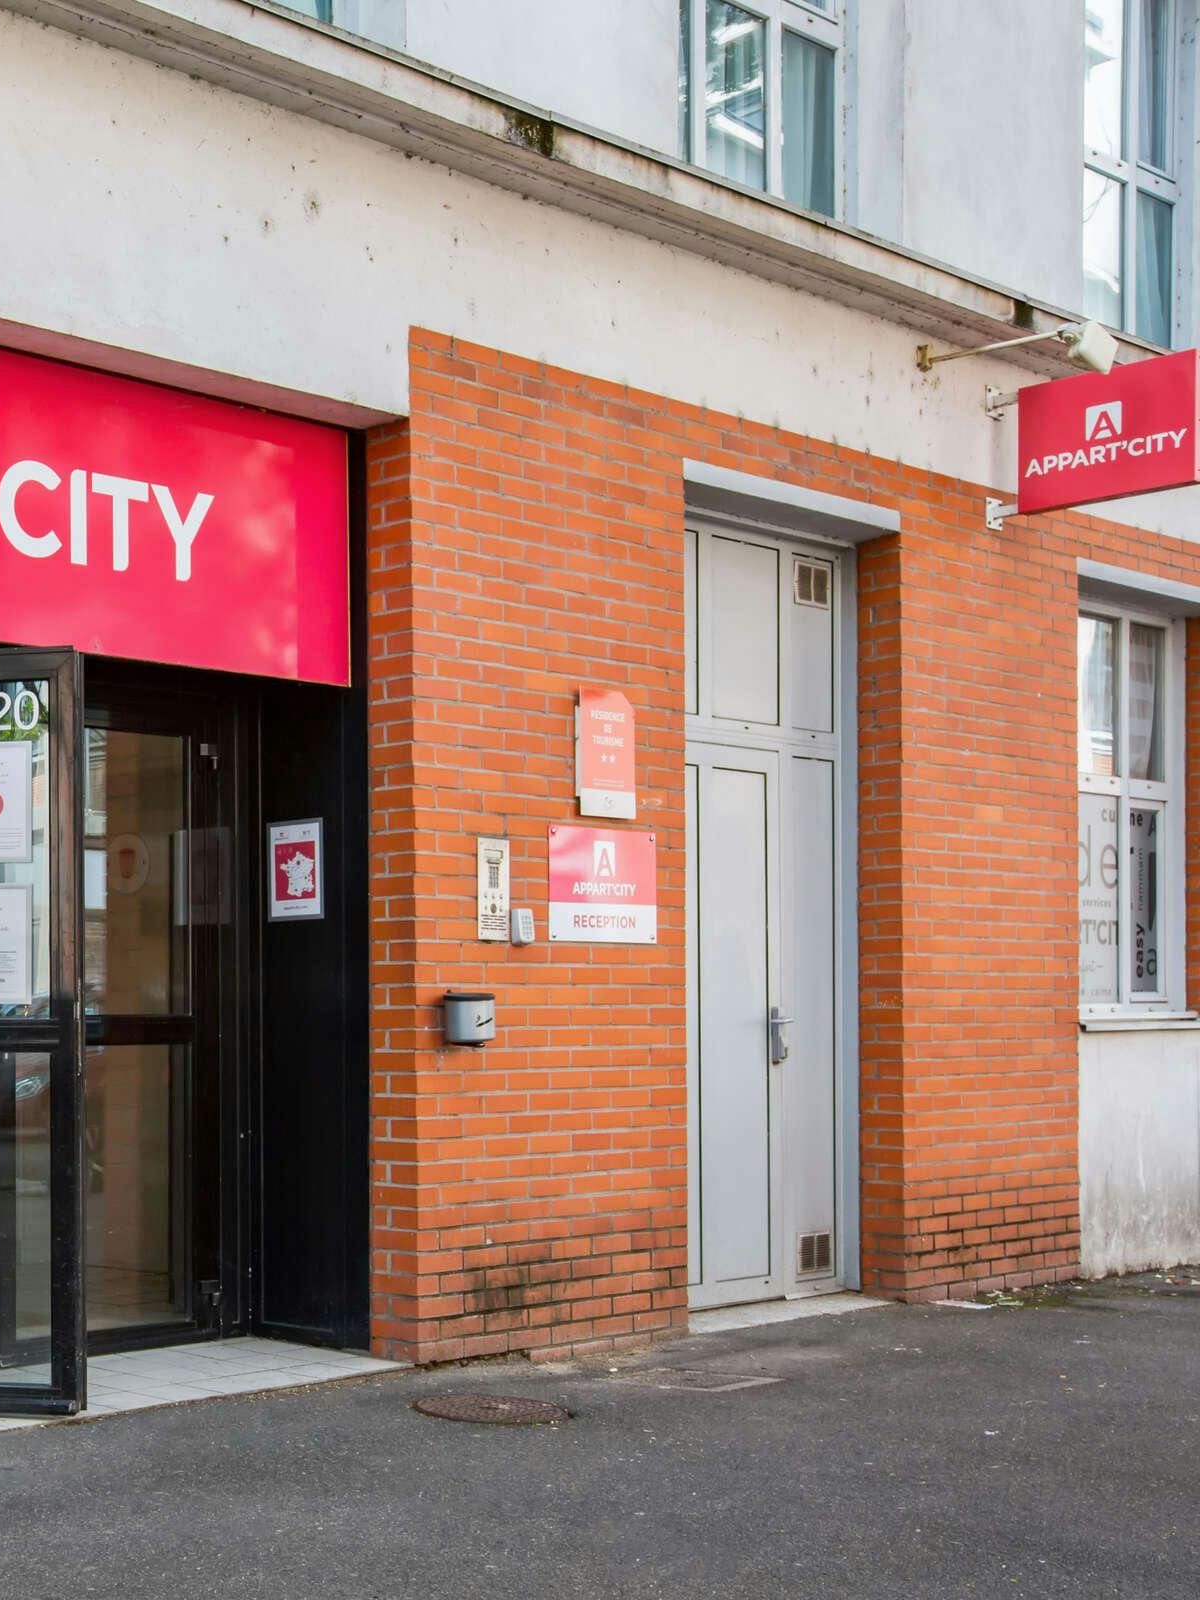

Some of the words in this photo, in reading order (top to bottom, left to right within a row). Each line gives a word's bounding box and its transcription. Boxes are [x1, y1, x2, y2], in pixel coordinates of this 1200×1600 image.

[1024, 428, 1188, 478] APPART'CITY
[572, 881, 637, 897] APPART'CITY
[573, 914, 637, 929] RECEPTION
[1136, 921, 1145, 978] easy
